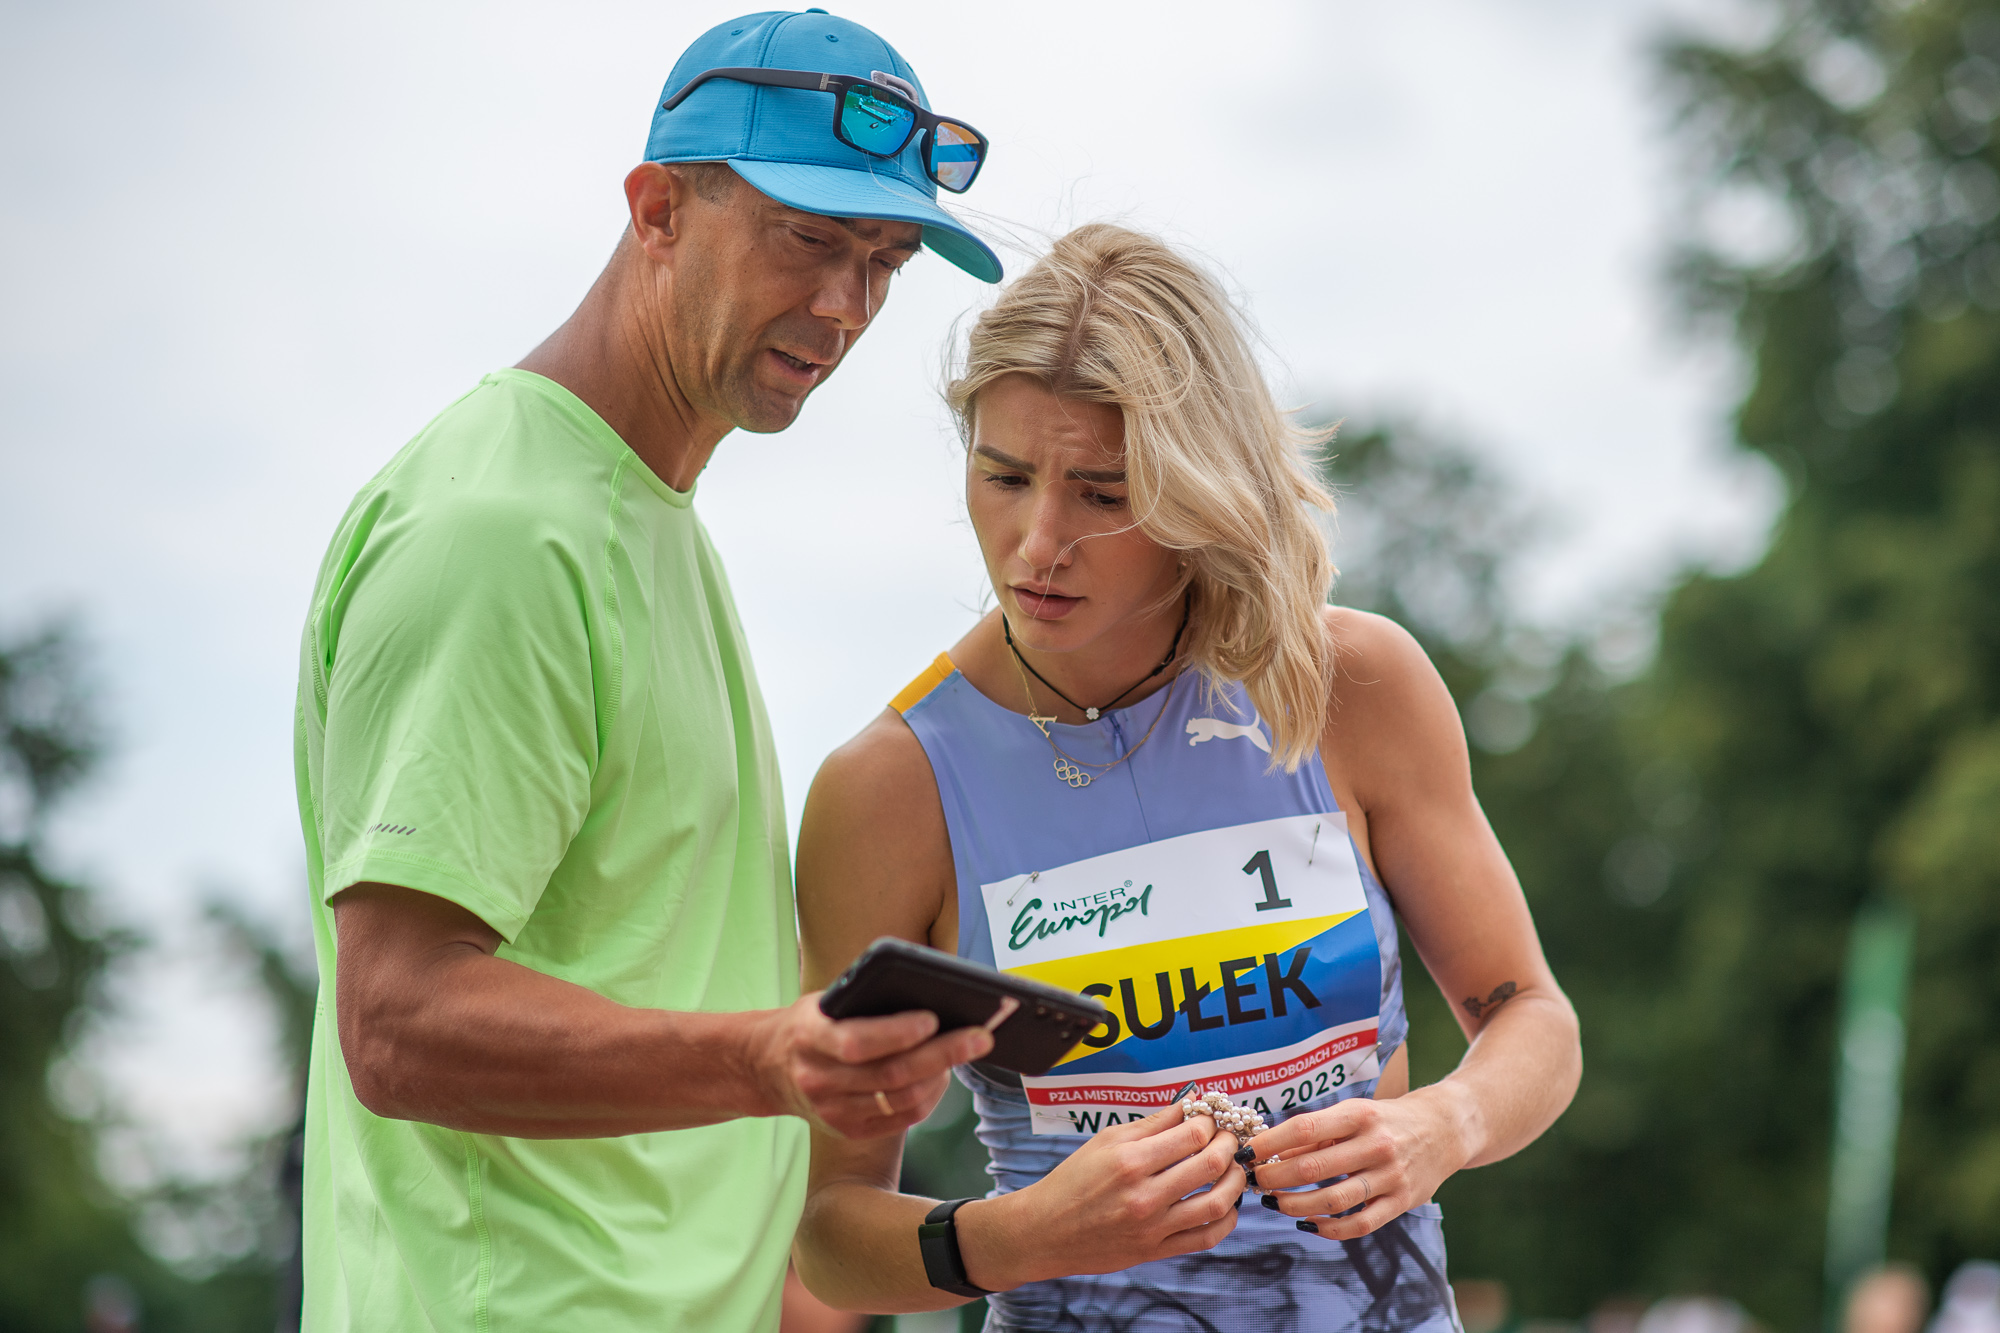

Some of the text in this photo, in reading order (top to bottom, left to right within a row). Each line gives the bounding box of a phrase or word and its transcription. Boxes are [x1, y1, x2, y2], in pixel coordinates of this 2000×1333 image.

[1242, 850, 1293, 912] 1
[1008, 884, 1152, 950] Europol
[1079, 947, 1322, 1049] SUŁEK
[1049, 1036, 1358, 1103] PZLA MISTRZOSTWA LSKI W WIELOBOJACH 2023
[1281, 1063, 1345, 1111] 2023
